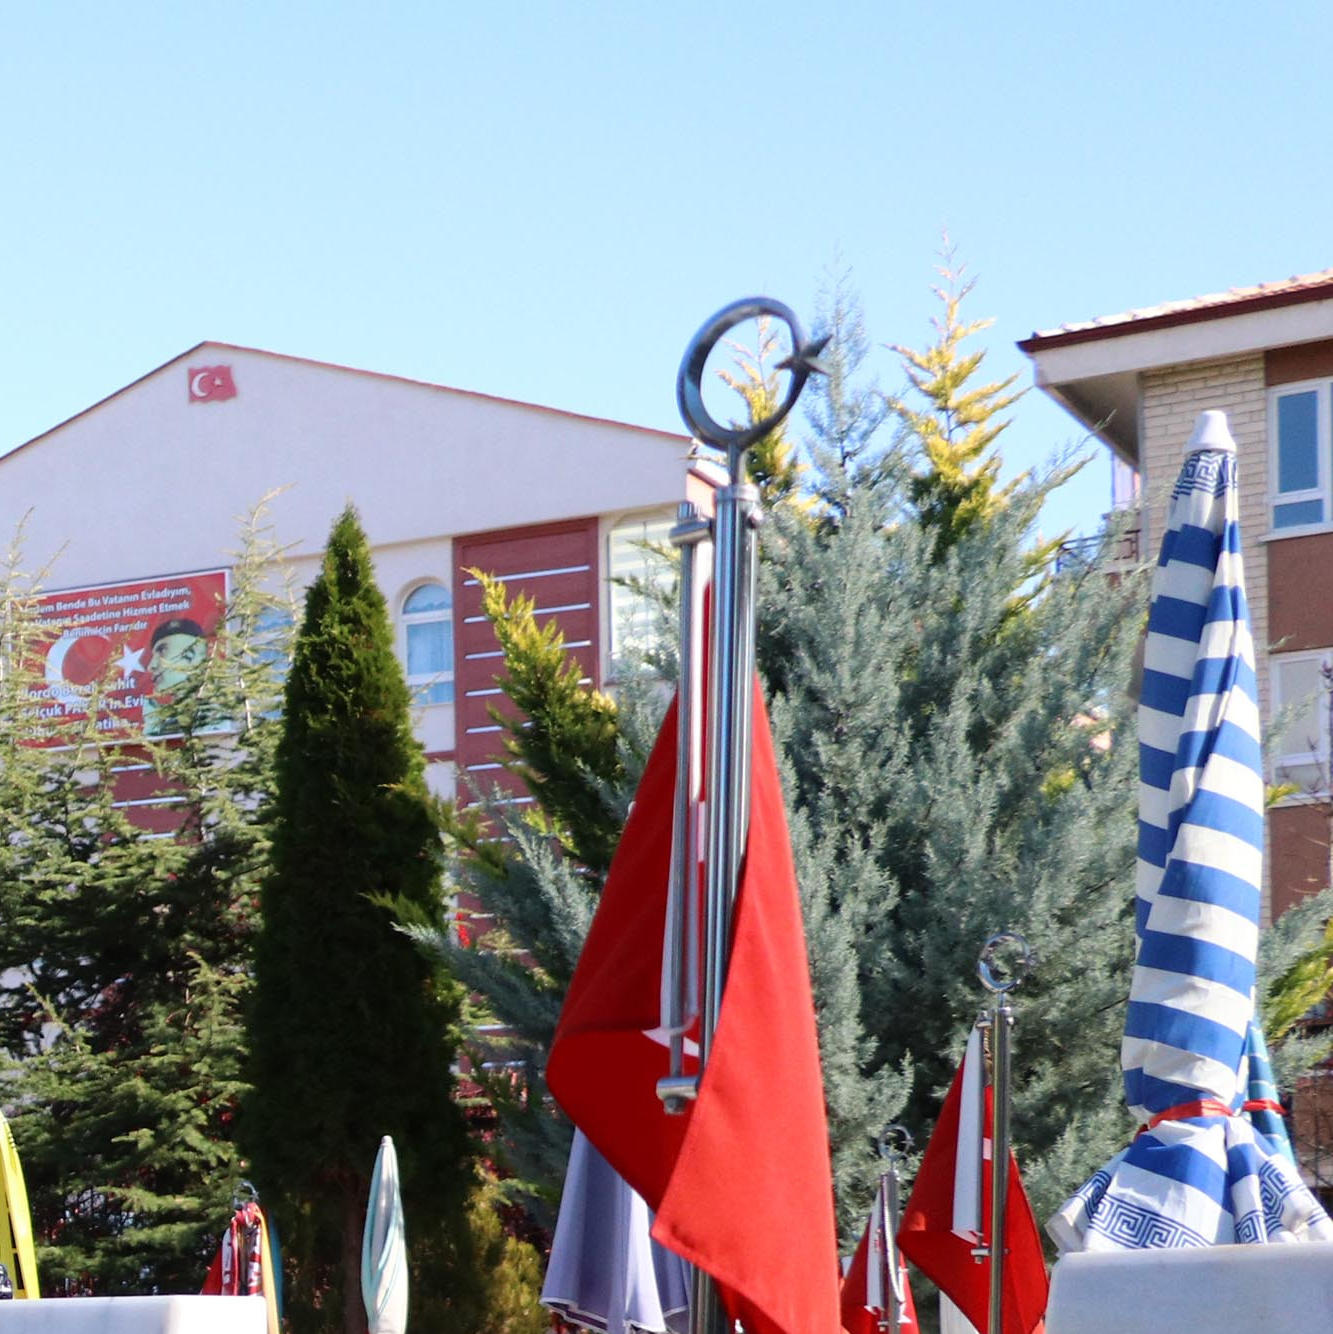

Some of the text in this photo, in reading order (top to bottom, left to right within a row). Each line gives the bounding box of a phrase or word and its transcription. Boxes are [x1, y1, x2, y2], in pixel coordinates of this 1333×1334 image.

[56, 598, 86, 611] Bende
[88, 596, 101, 607] Bu
[102, 592, 139, 606] Vatanın
[122, 604, 157, 617] Hizmet
[159, 600, 190, 613] Etmek
